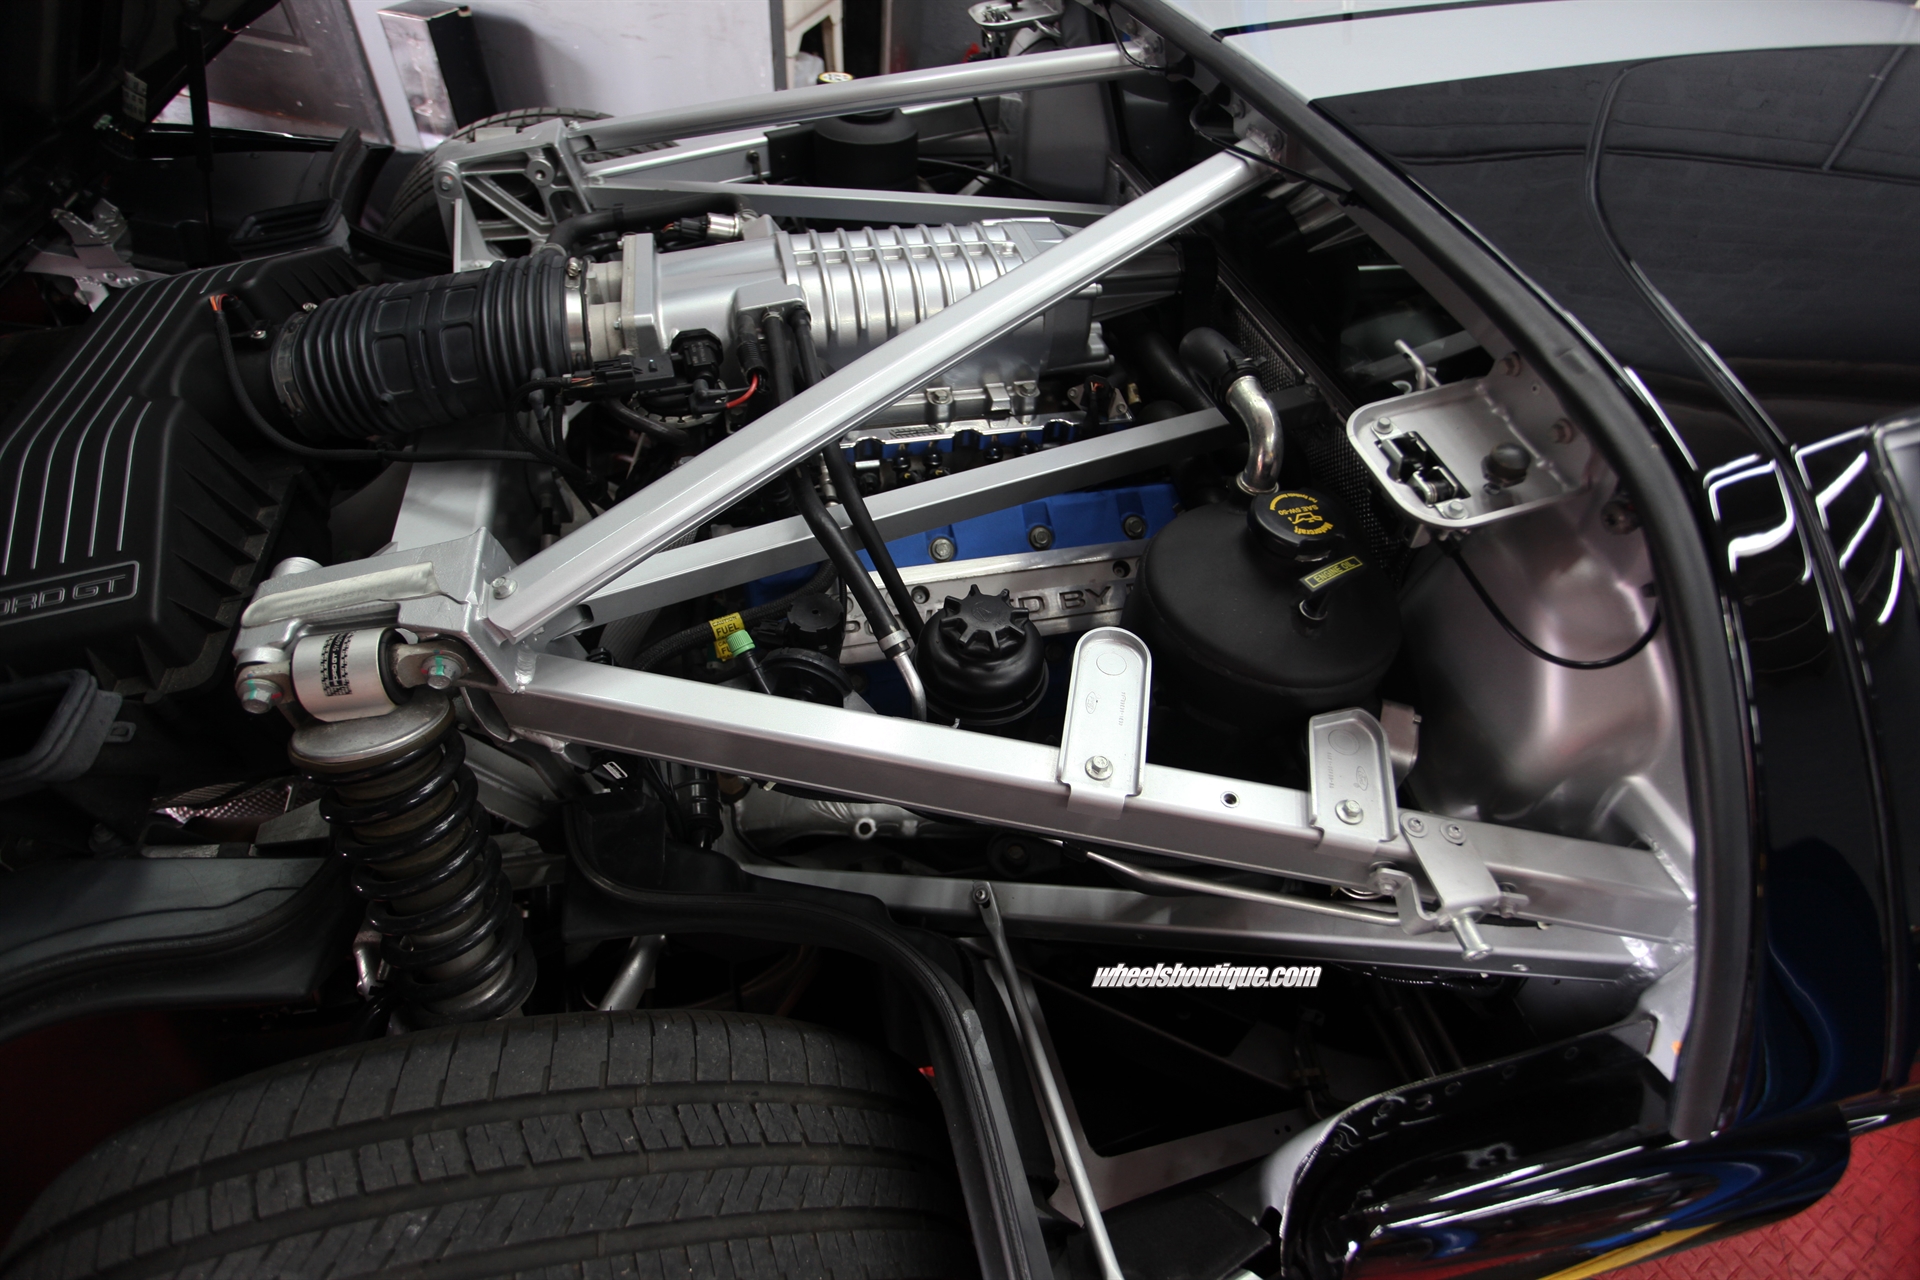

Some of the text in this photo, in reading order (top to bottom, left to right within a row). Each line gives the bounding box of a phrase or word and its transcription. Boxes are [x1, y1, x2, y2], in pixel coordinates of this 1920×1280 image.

[1277, 504, 1319, 516] SAE 5W-50
[1294, 521, 1334, 535] Motorcraft
[1313, 560, 1356, 583] ENGINE OIL
[72, 573, 126, 600] GT
[1059, 585, 1112, 611] BY
[715, 622, 740, 637] FUEL
